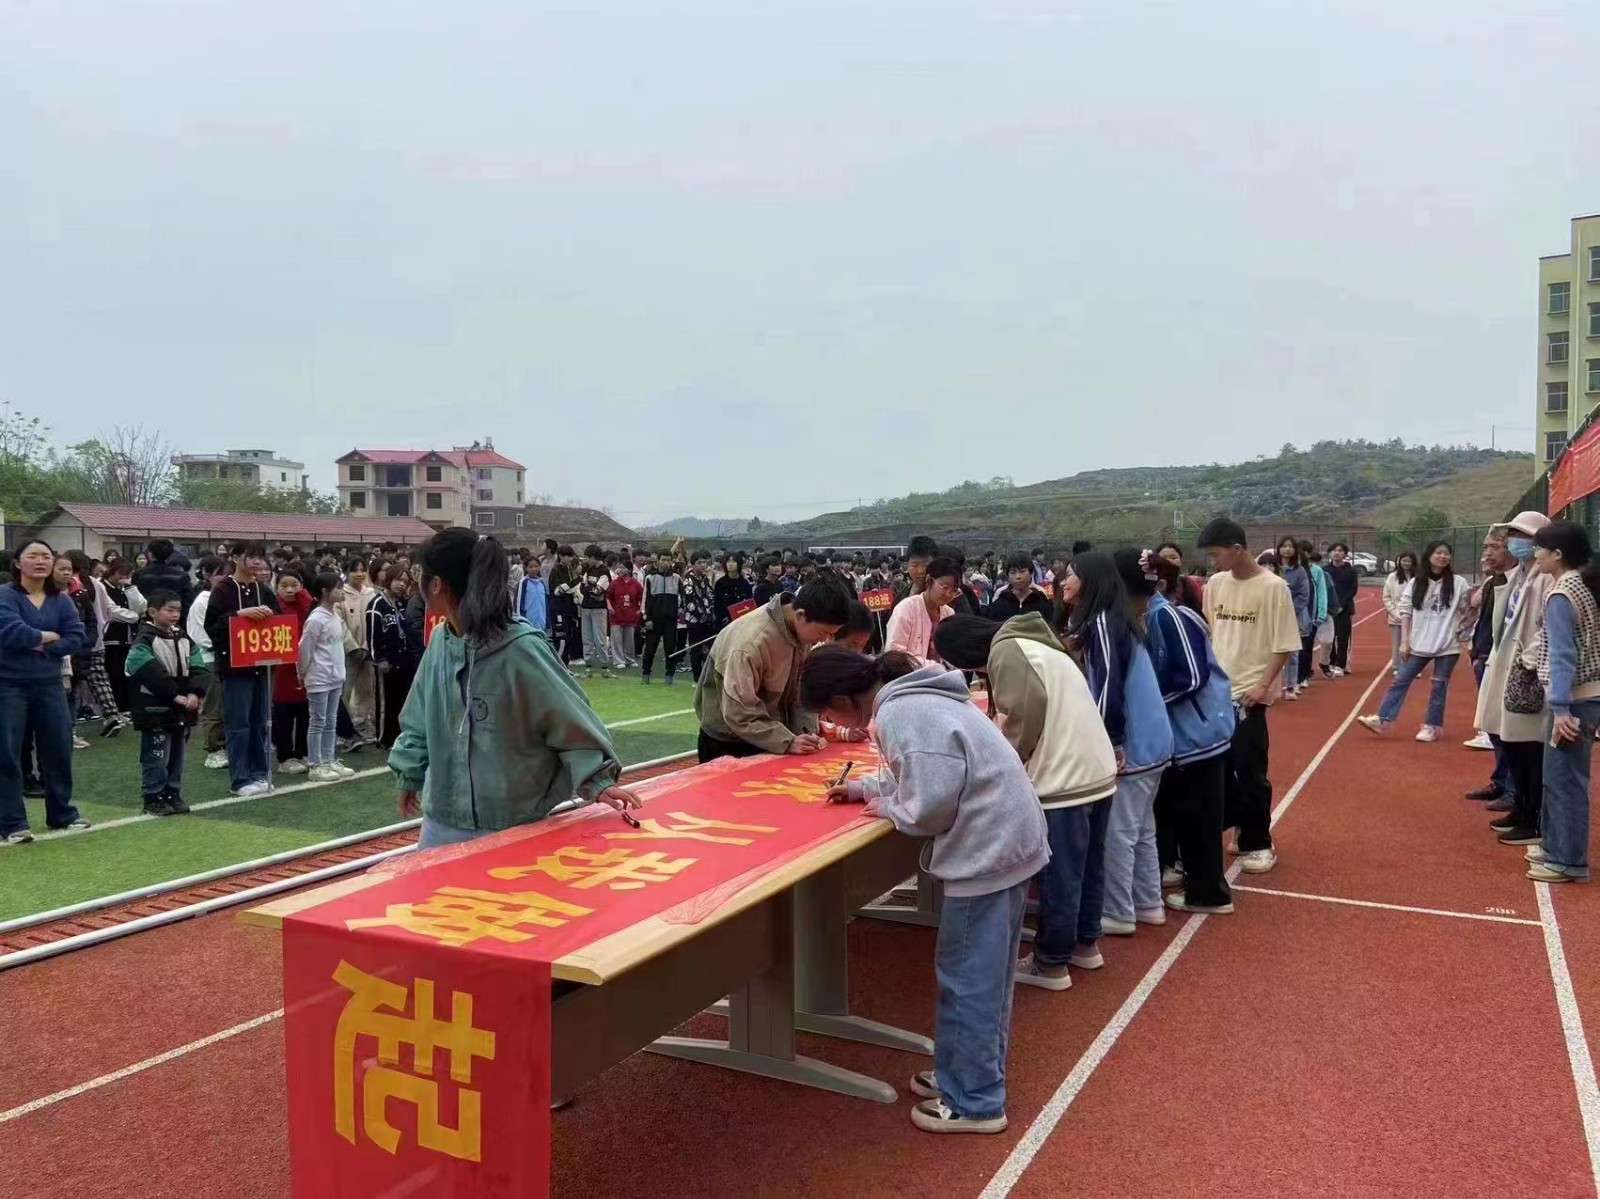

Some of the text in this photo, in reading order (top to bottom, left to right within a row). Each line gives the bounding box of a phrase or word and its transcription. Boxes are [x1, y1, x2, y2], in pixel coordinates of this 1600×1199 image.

[863, 593, 891, 607] 188班
[237, 624, 293, 654] 193班
[331, 809, 779, 1162] 从我做起
